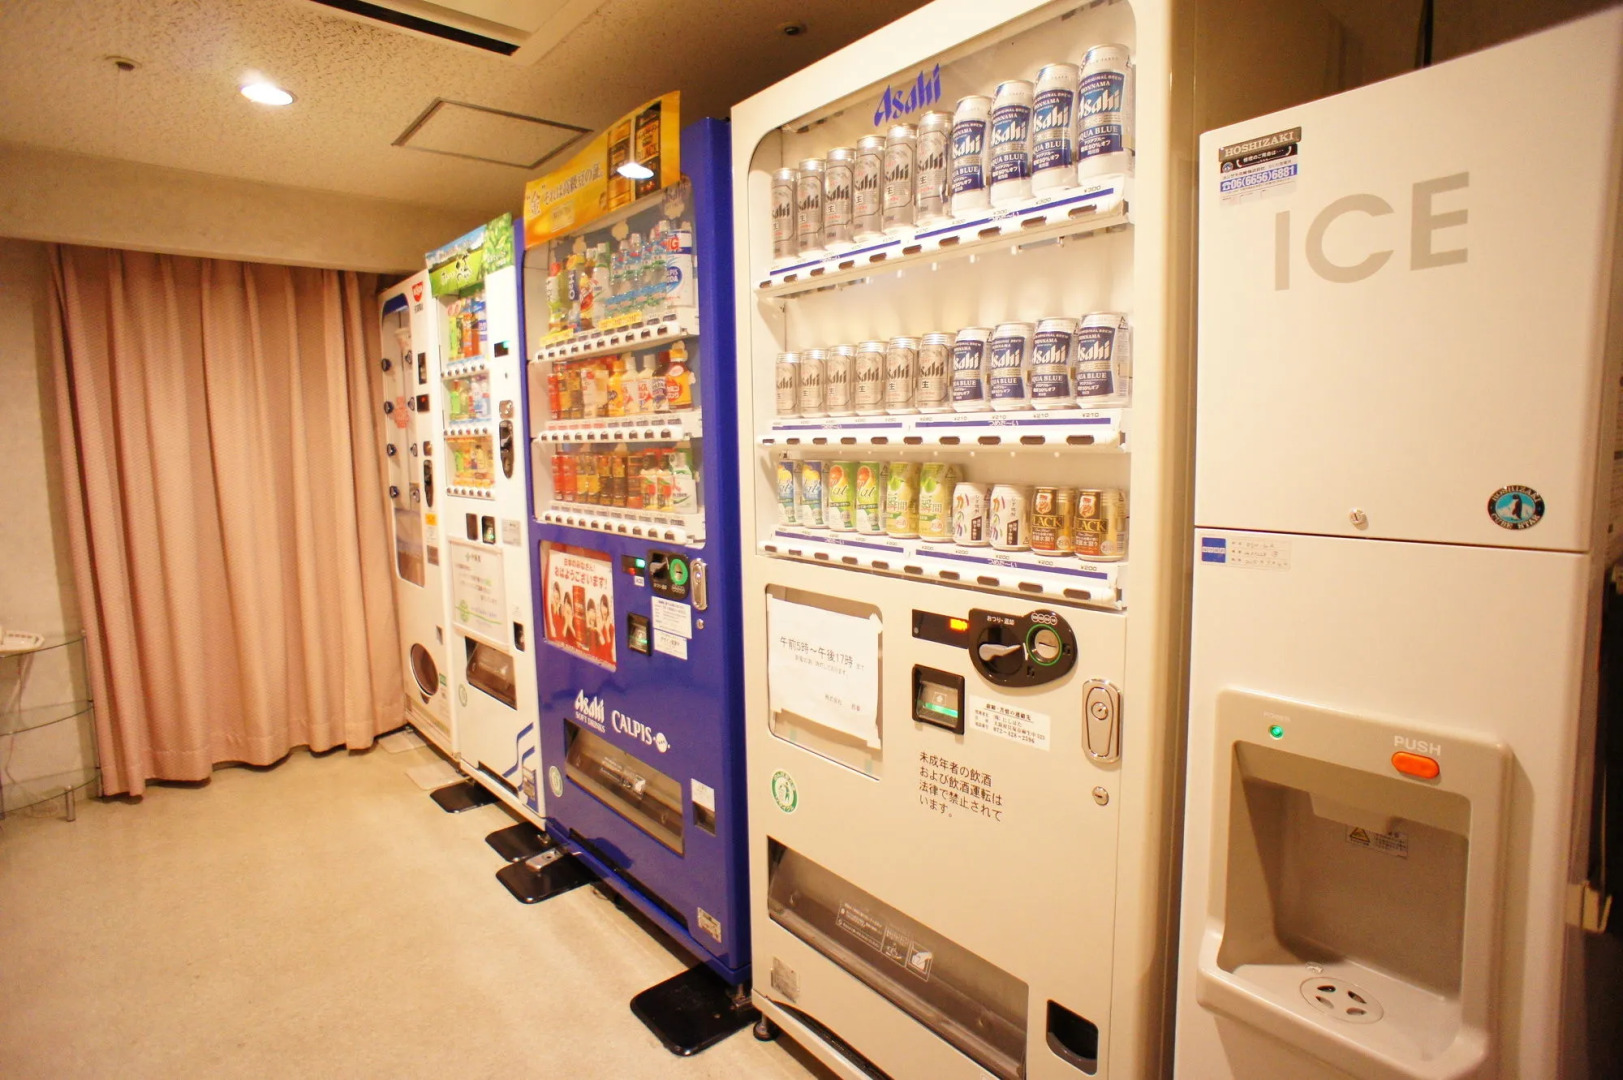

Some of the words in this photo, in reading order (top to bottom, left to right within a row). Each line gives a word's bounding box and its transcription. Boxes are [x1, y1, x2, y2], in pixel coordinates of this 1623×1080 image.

[873, 62, 943, 126] Asahi
[1045, 140, 1067, 148] BLUE
[1095, 125, 1119, 135] BLUE
[1224, 131, 1295, 158] HOSHIZAKI
[1003, 153, 1024, 161] BLUE
[1274, 171, 1470, 292] ICE
[554, 566, 608, 590] おはようございます!
[574, 689, 605, 724] Asahi
[611, 710, 653, 746] CALPIS
[1393, 735, 1442, 757] PUSH
[919, 750, 992, 788] 未成年者の飲酒
[919, 765, 1003, 806] および飲酒運転は
[919, 780, 1003, 822] 法律で禁止されて
[919, 794, 953, 818] います。
